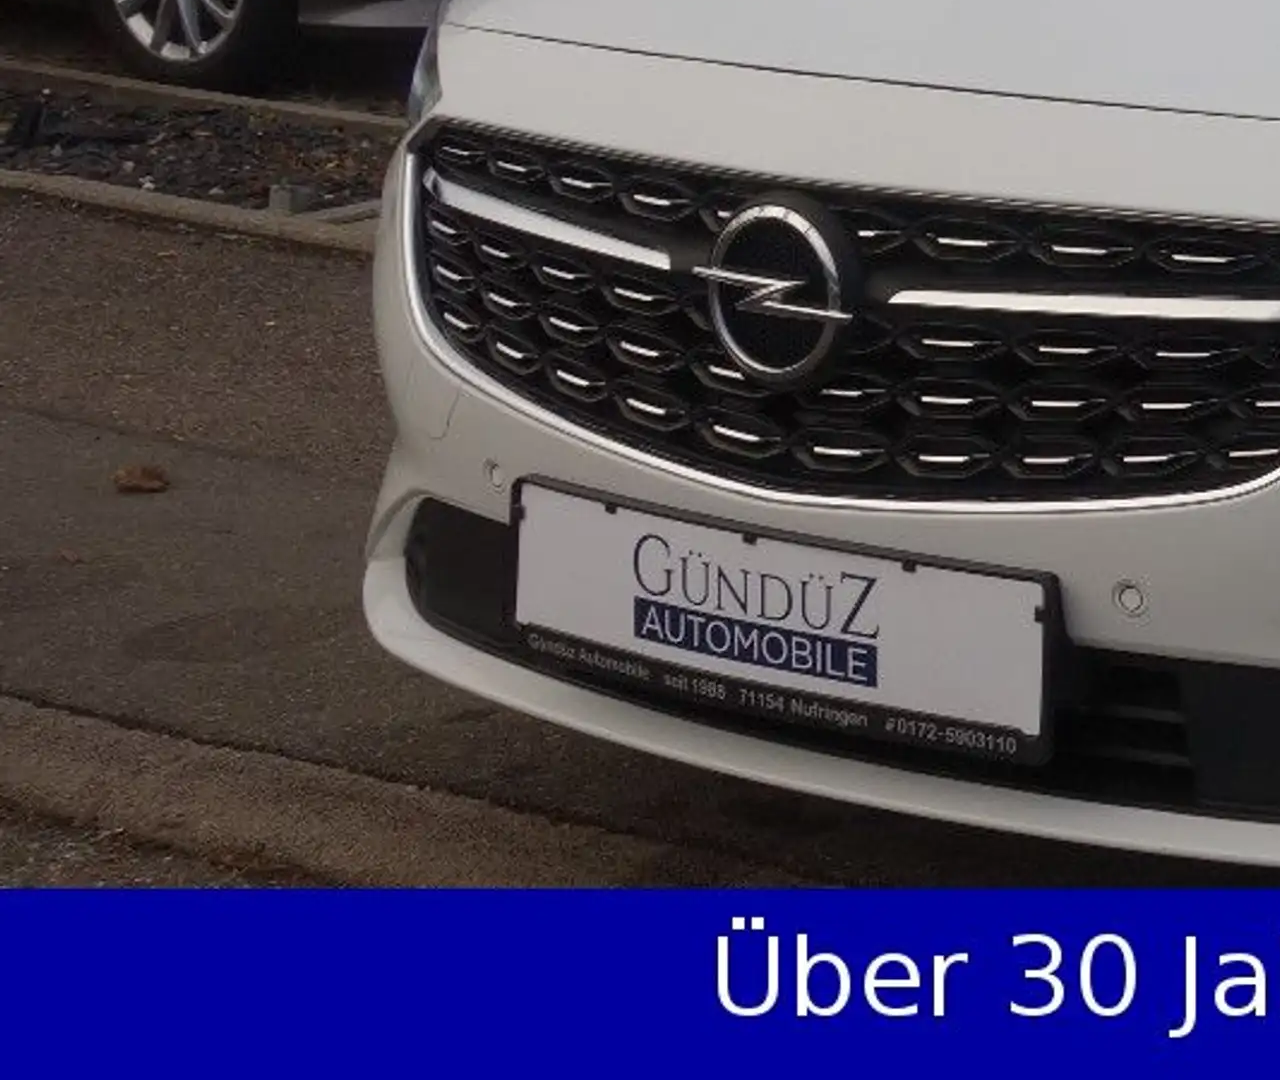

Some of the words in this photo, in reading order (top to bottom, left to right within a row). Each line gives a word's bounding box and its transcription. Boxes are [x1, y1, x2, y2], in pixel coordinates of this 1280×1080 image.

[641, 606, 869, 681] AUTOMOBILE
[740, 688, 784, 712] 71154
[790, 698, 868, 727] Nufringen
